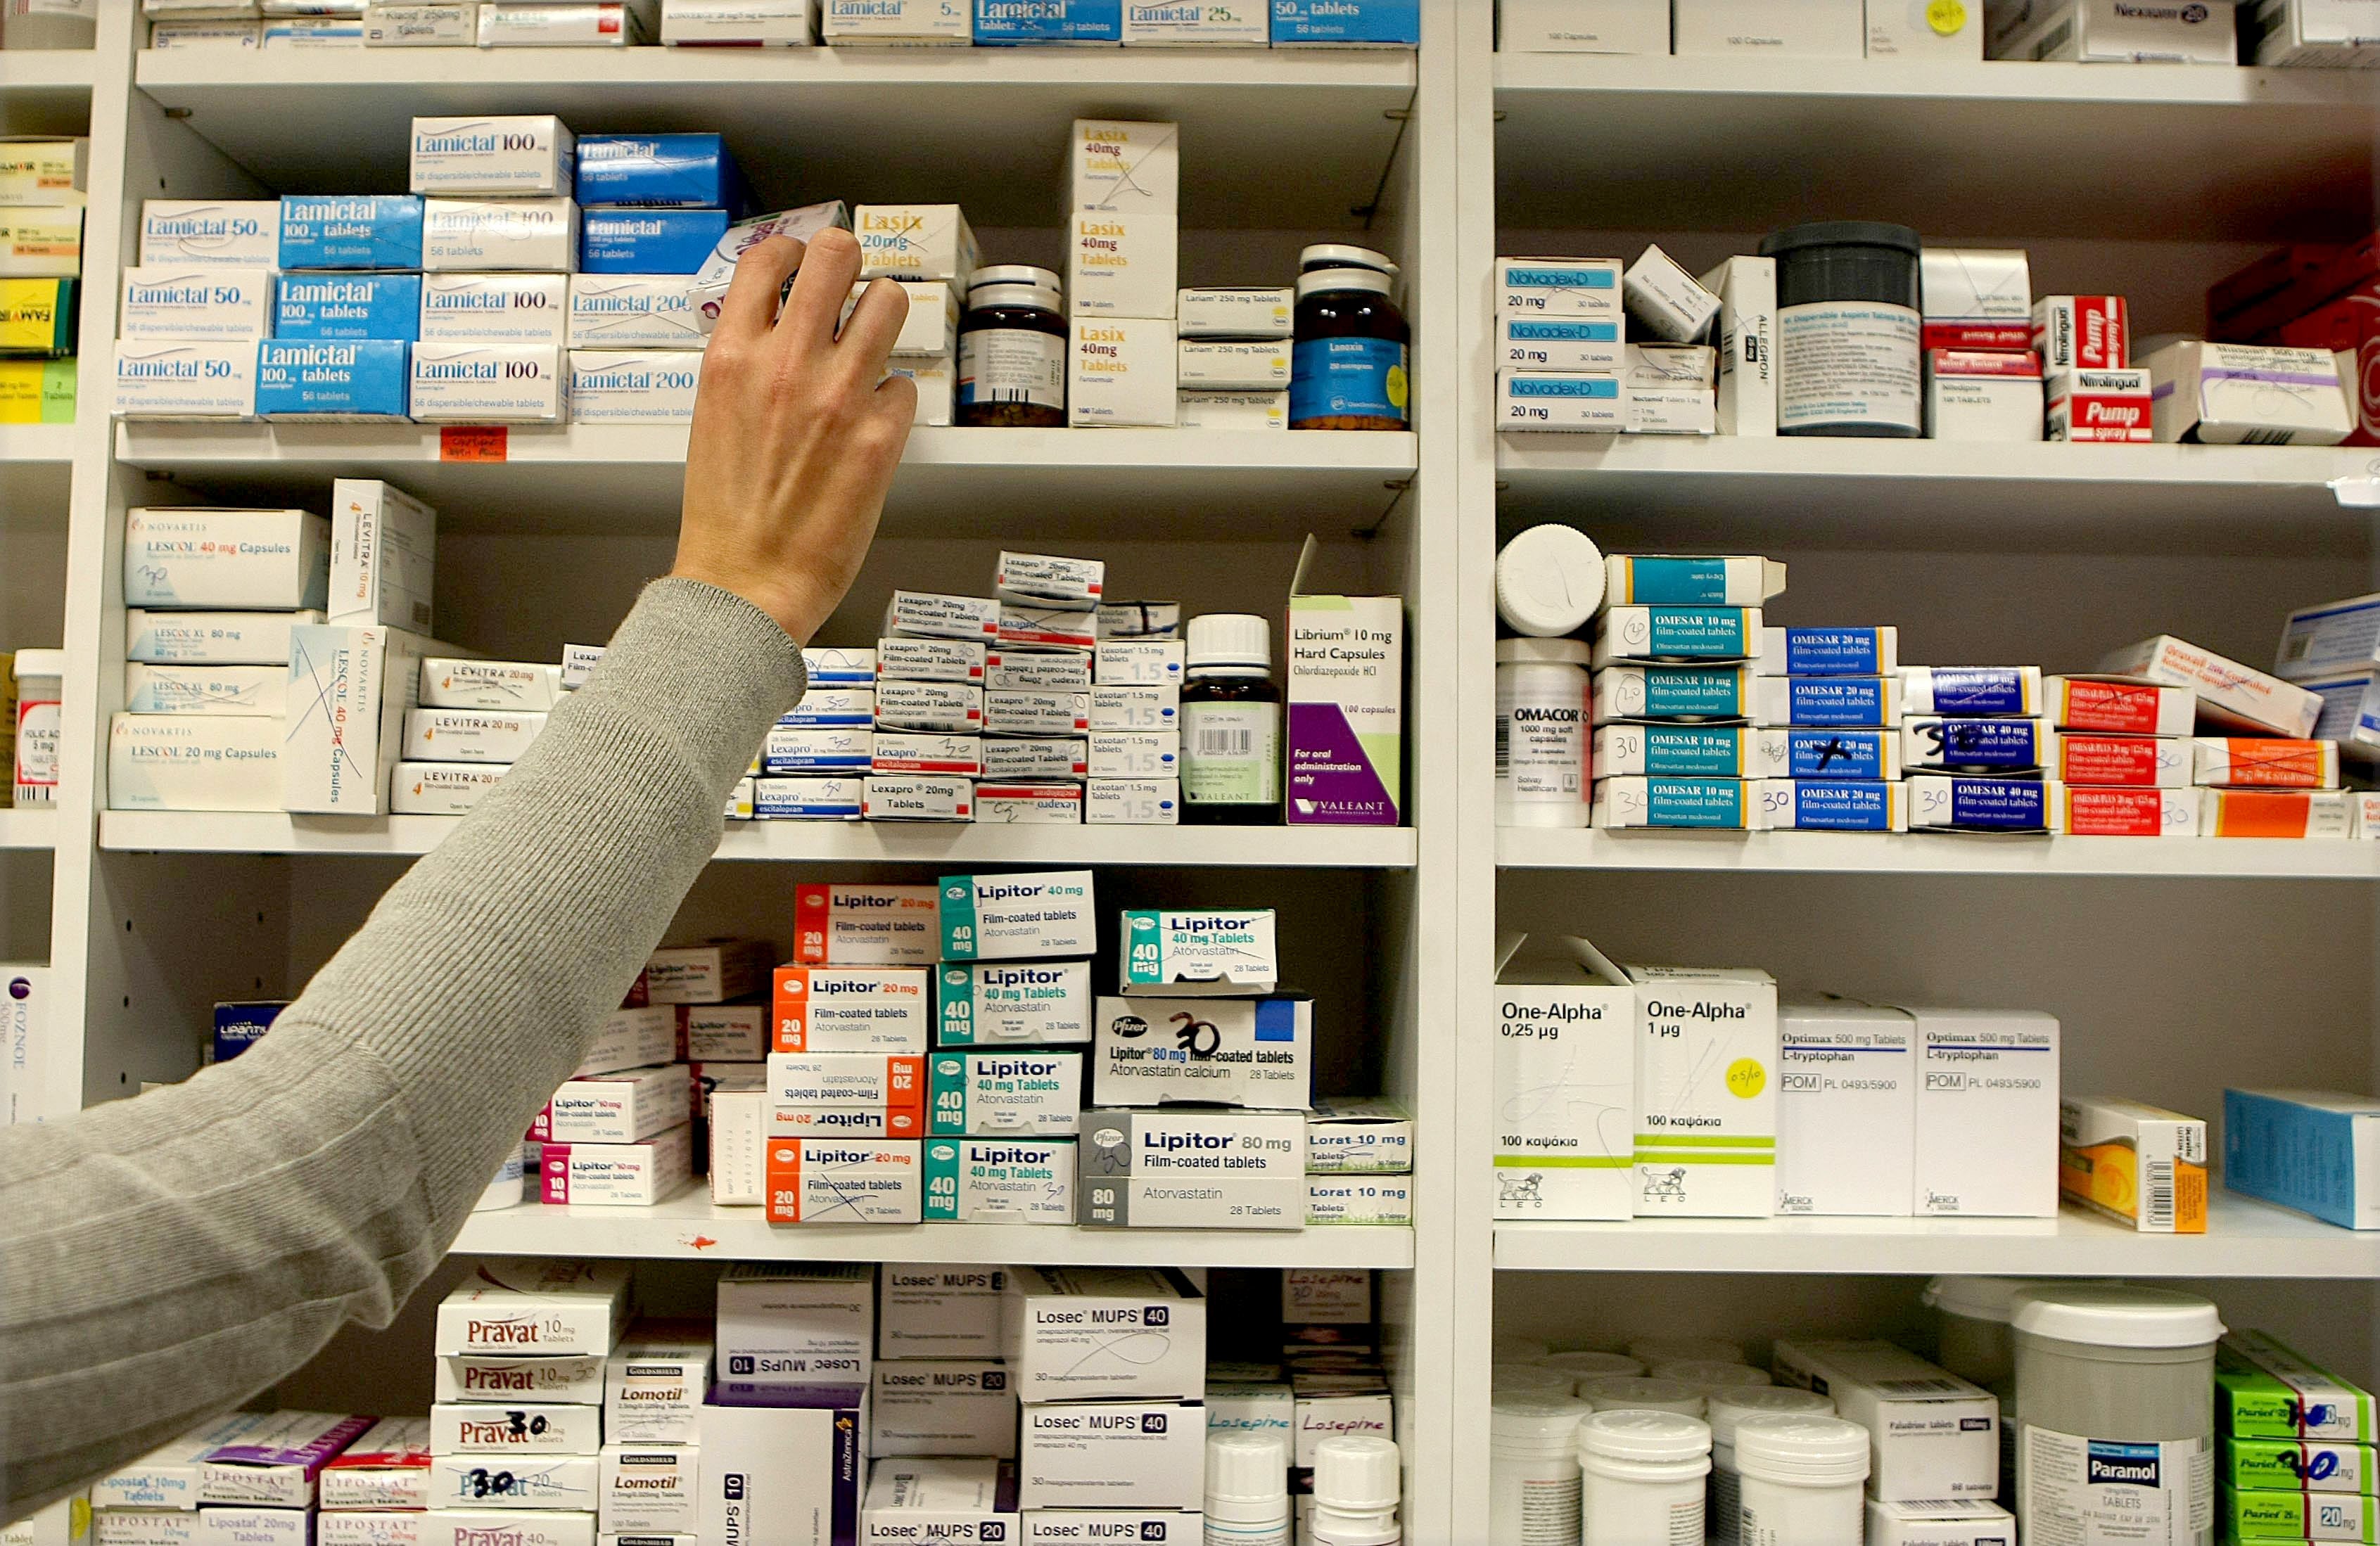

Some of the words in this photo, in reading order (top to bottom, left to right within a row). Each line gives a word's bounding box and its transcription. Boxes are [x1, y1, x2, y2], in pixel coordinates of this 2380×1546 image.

[1276, 2, 1296, 15] 50
[1311, 2, 1358, 15] tablets
[862, 210, 922, 231] Lasix
[1081, 221, 1126, 236] Lasix
[862, 236, 908, 251] 20mg
[1081, 238, 1117, 251] 40mg
[863, 253, 921, 267] Tablets
[1081, 254, 1127, 267] Tablets
[1508, 271, 1589, 286] Nolvadex-D
[1237, 296, 1250, 305] mg
[1253, 295, 1281, 303] Tablets
[1508, 295, 1524, 306] 20
[1527, 297, 1545, 309] mg
[1759, 314, 1769, 380] ALLEGRON
[262, 344, 356, 365] Lamictal
[117, 359, 198, 378] Lamictal
[205, 361, 230, 378] 50
[415, 361, 499, 379] Lamictal
[505, 361, 538, 379] 100
[262, 369, 286, 381] 100
[303, 369, 350, 382] tablets
[573, 371, 651, 389] Lamictal
[656, 371, 694, 388] 200
[2079, 376, 2141, 390] Nitrolingual
[516, 399, 545, 408] tablets
[2086, 402, 2139, 427] Pump
[2093, 427, 2129, 440] spray
[201, 542, 216, 552] 40
[219, 544, 236, 555] mg
[240, 543, 291, 554] Capsules
[898, 596, 934, 606] Lexapro
[942, 600, 965, 611] 20mg
[898, 607, 947, 618] Film-coated
[950, 612, 979, 622] Tablets
[1655, 615, 1703, 625] OMESAR
[1722, 618, 1736, 627] mg
[1353, 630, 1368, 641] 10
[1371, 632, 1392, 644] mg
[1656, 627, 1705, 636] film-coated
[1707, 627, 1736, 636] tablets
[1294, 649, 1325, 659] Hard
[1330, 649, 1385, 660] Capsules
[1131, 662, 1161, 681] 1.5
[1294, 665, 1359, 678] Chlordiazepoxide
[1361, 705, 1396, 714] capsules
[1515, 708, 1579, 722] OMACOR
[435, 717, 489, 728] LEVITRA
[504, 722, 518, 731] mg
[1520, 725, 1539, 734] 1000
[1558, 725, 1573, 734] soft
[1530, 735, 1567, 743] capsules
[186, 747, 201, 757] 20
[204, 749, 222, 760] mg
[226, 748, 276, 759] Capsules
[771, 744, 810, 753] Lexapro
[1314, 749, 1331, 758] oral
[1616, 736, 1638, 758] 30
[1294, 762, 1361, 772] administration
[1294, 774, 1314, 784] only
[1517, 776, 1542, 785] Solvay
[872, 784, 913, 796] Lexapro
[926, 786, 953, 797] 20mg
[1517, 784, 1557, 793] Healthcare
[1801, 789, 1849, 798] OMESAR
[1852, 789, 1864, 798] 20
[1865, 791, 1881, 800] mg
[886, 798, 924, 809] Tablets
[1321, 801, 1385, 810] VALEANT
[1802, 800, 1851, 810] film-coated
[1852, 801, 1881, 810] tablets
[1922, 790, 1947, 812] 30
[984, 969, 1064, 986] Lipitor
[813, 980, 876, 995] Lipitor
[883, 984, 897, 993] 20
[900, 984, 918, 995] mg
[984, 987, 1000, 999] 40
[1002, 988, 1021, 1001] mg
[1023, 986, 1067, 999] Tablets
[815, 1008, 872, 1019] Film-coated
[874, 1008, 908, 1018] tablets
[984, 1001, 1051, 1014] Atorvastatin
[815, 1021, 871, 1032] Atorvastatin
[1501, 1023, 1534, 1037] 0,25
[1539, 1024, 1558, 1040] μg
[1169, 1011, 1221, 1056] 30
[1782, 1033, 1833, 1044] Optimax
[1835, 1034, 1853, 1044] 500
[1857, 1036, 1871, 1046] mg
[1873, 1035, 1906, 1045] Tablets
[1782, 1052, 1855, 1062] L-tryptophan
[1110, 1064, 1183, 1077] Atorvastatin
[1185, 1066, 1230, 1078] calcium
[1782, 1075, 1817, 1089] POM
[1824, 1080, 1838, 1089] PL
[1842, 1079, 1897, 1090] 0493/5900
[1144, 1132, 1234, 1151] Lipitor
[1242, 1137, 1264, 1149] 80
[1266, 1139, 1292, 1152] mg
[1501, 1136, 1522, 1146] 100
[1526, 1135, 1578, 1148] καψάκια
[573, 1162, 611, 1172] Lipitor
[1144, 1155, 1221, 1168] Film-coated
[1224, 1156, 1266, 1168] tablets
[1144, 1187, 1223, 1199] Atorvastatin
[1310, 1187, 1352, 1197] Lorat
[1358, 1187, 1375, 1197] 10
[1382, 1189, 1406, 1199] mg
[1230, 1206, 1242, 1215] 28
[1245, 1206, 1281, 1215] Tablets
[1036, 1310, 1083, 1324] Losec
[1092, 1310, 1139, 1324] MUPS
[1147, 1310, 1166, 1322] 40
[468, 1320, 539, 1343] Pravat
[544, 1320, 561, 1334] 10
[621, 1388, 682, 1400] Lomotil
[506, 1411, 547, 1435] 30
[1302, 1414, 1385, 1432] Losepine
[844, 1429, 852, 1481] AstraZeneca
[2091, 1460, 2156, 1481] Paramol
[155, 1478, 186, 1490] 10mg
[469, 1468, 515, 1497] 30
[124, 1491, 164, 1502] Tablets
[2102, 1497, 2142, 1509] TABLETS
[2322, 1507, 2341, 1526] 20
[2343, 1518, 2355, 1531] mg
